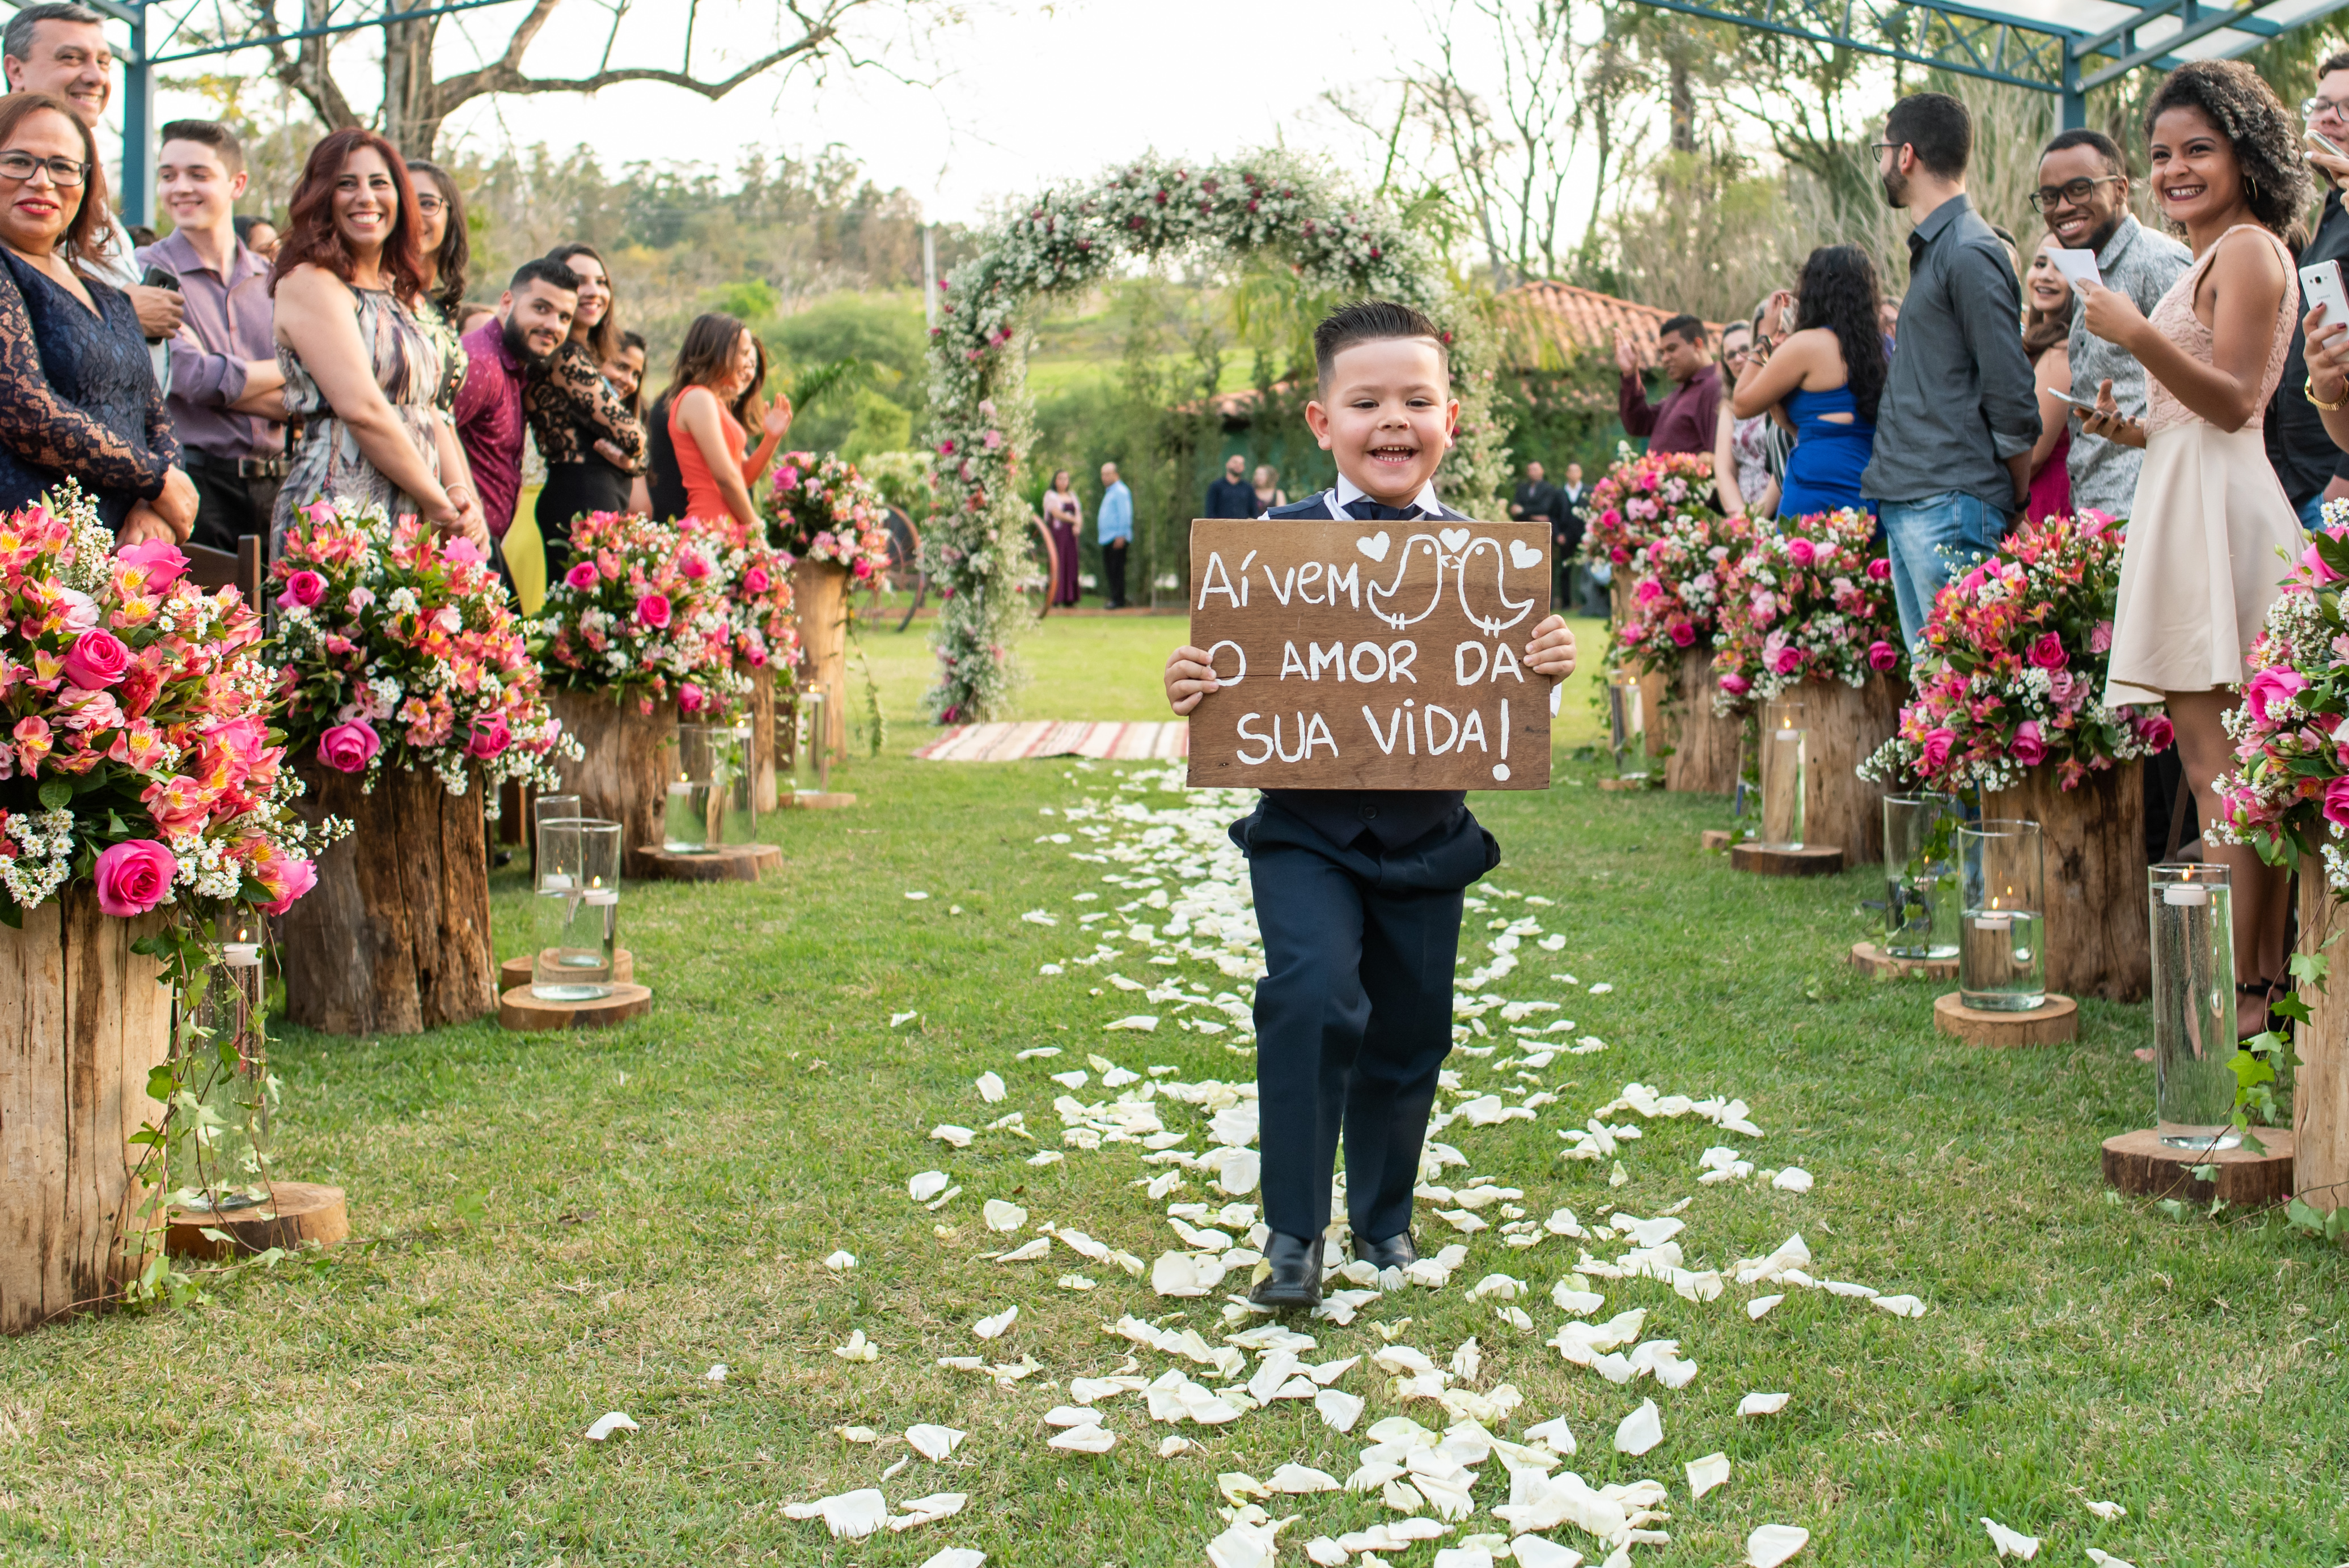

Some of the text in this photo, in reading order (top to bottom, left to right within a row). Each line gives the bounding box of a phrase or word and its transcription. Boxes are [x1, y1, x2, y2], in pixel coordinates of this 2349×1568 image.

[1197, 549, 1258, 611] Aí
[1208, 639, 1525, 686] O AMOR DA
[1236, 711, 1339, 765] SUA
